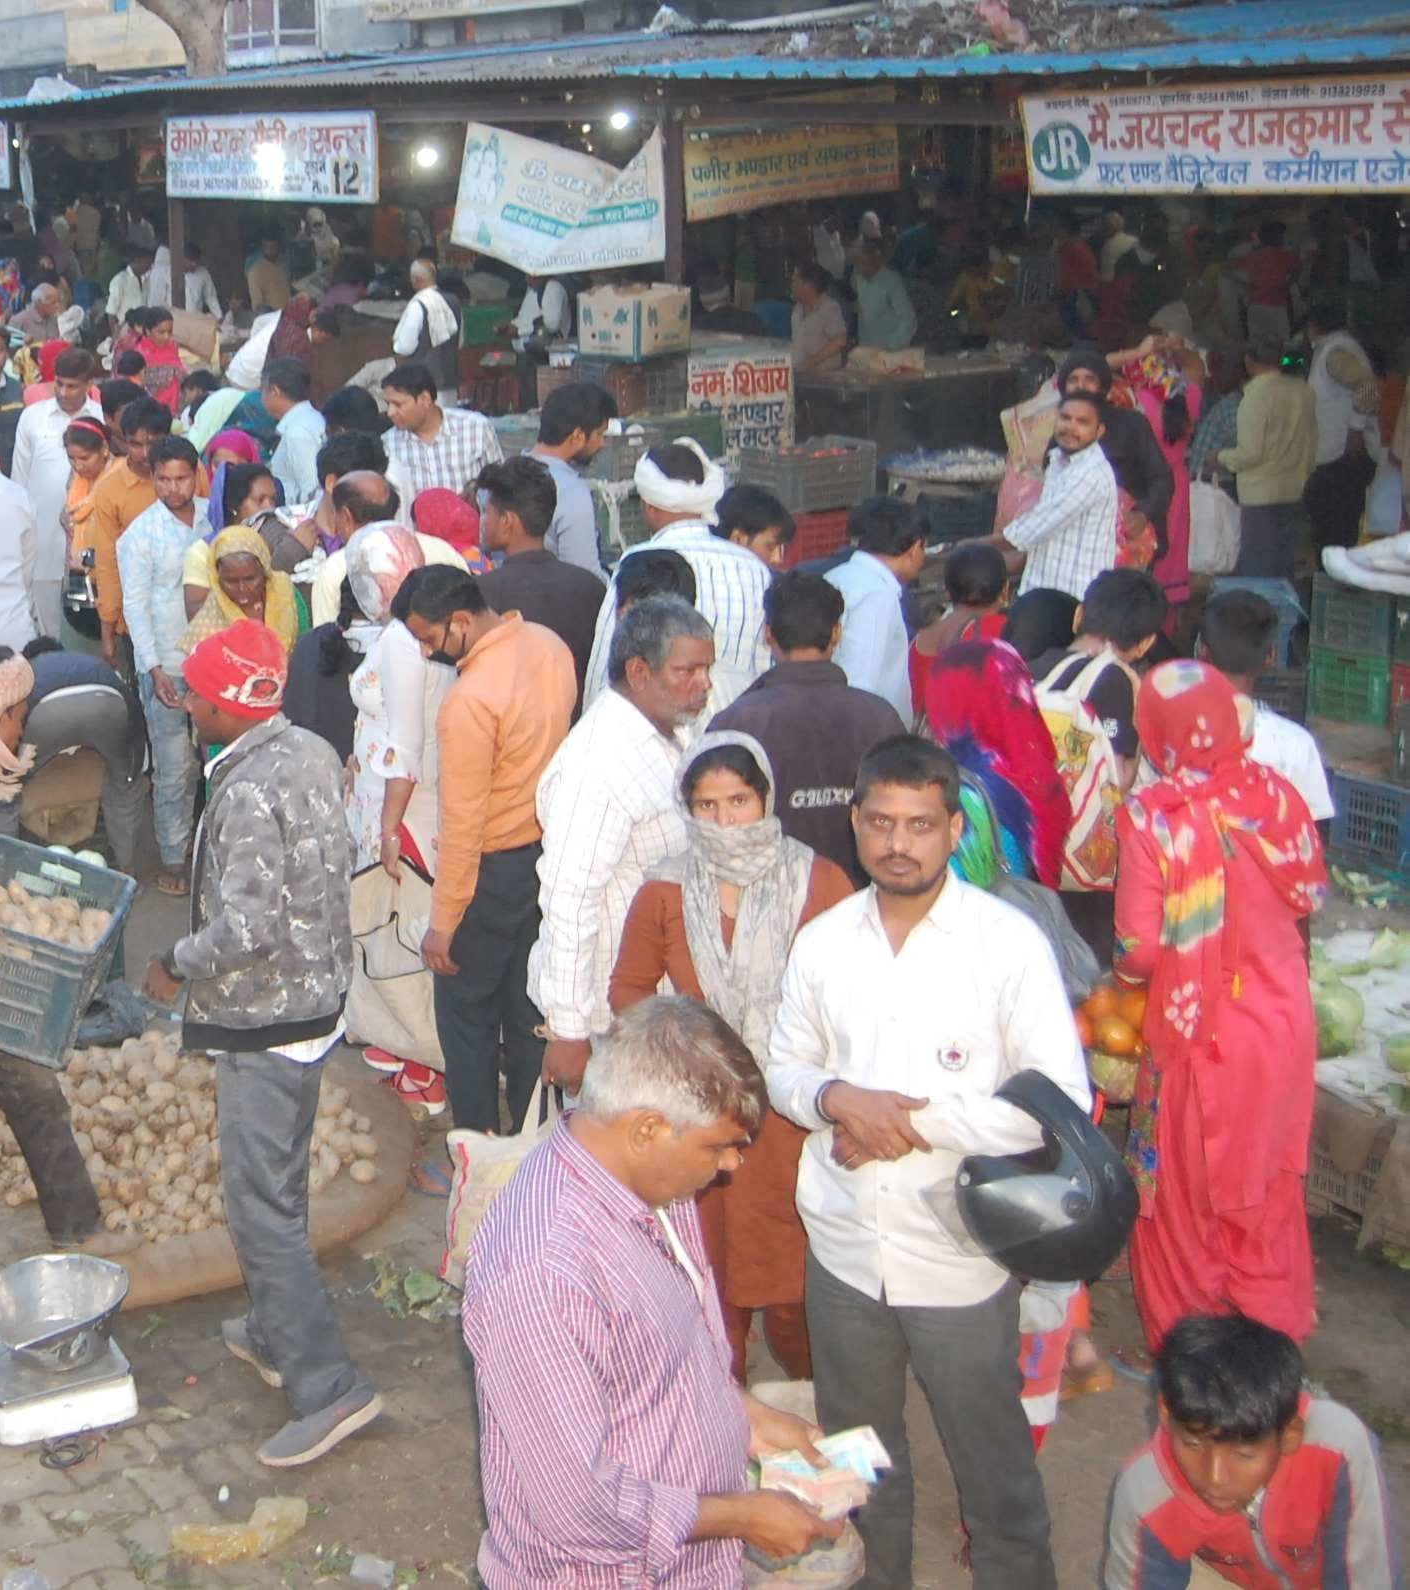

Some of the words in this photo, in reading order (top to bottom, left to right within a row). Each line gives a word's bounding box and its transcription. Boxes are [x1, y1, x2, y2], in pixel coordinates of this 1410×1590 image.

[1228, 103, 1375, 159] राजकुमार
[1040, 128, 1081, 171] JR
[1262, 149, 1359, 183] कमीशन
[332, 159, 360, 195] 12
[733, 361, 790, 397] शिवाय
